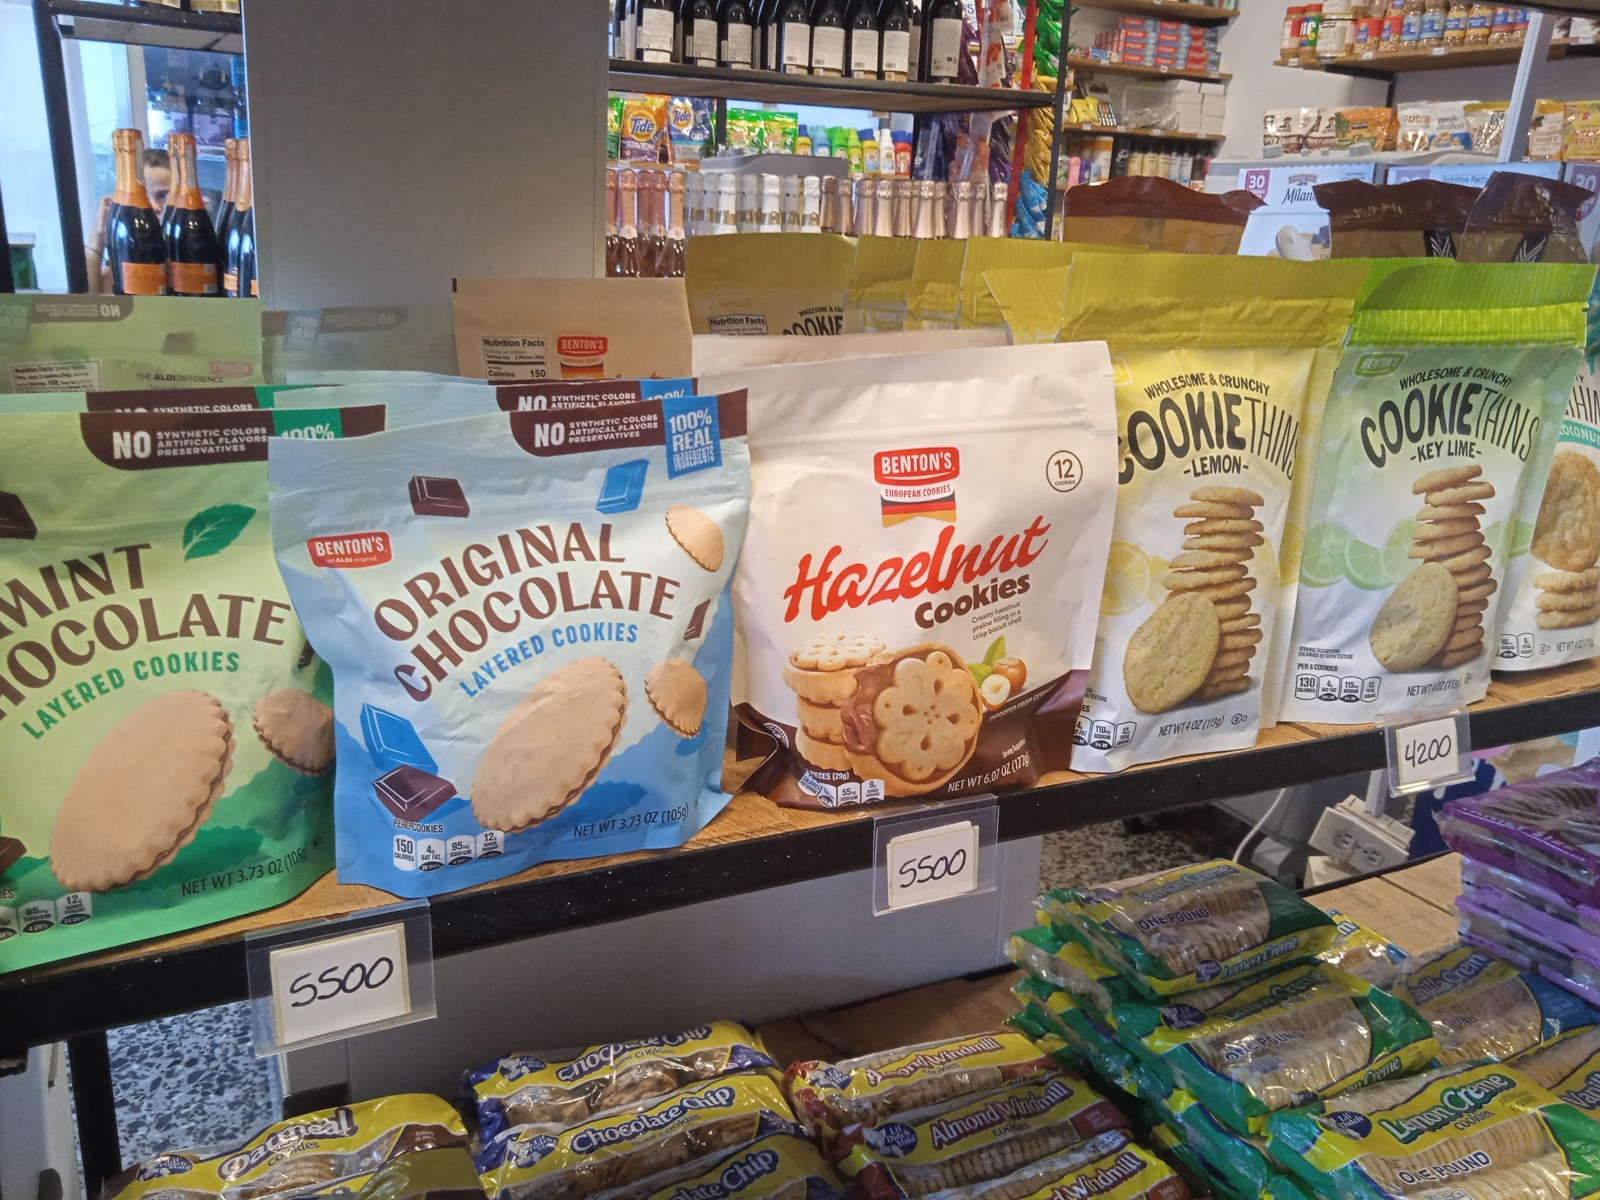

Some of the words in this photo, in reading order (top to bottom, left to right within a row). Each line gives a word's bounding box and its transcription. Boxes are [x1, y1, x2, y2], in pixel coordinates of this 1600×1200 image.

[630, 117, 655, 135] Tide
[673, 110, 691, 124] Tide
[1248, 175, 1265, 189] 30
[711, 317, 745, 327] Nutrition
[745, 316, 766, 325] Facts
[483, 339, 520, 347] Nutrition
[522, 339, 545, 347] Facts
[561, 339, 604, 350] BENTON'S
[488, 370, 515, 378] Calories
[530, 369, 546, 378] 150
[1400, 366, 1463, 391] WHOLESOME
[1463, 366, 1472, 378] &
[1472, 366, 1515, 388] CRUNCHY
[1144, 372, 1206, 400] WHOLESOME
[1209, 372, 1217, 386] &
[1218, 375, 1271, 397] CRUNCHY
[213, 403, 253, 412] COLORS
[518, 395, 548, 411] NO
[551, 394, 600, 403] SYNTHETIC
[601, 392, 636, 400] COLORS
[568, 418, 621, 430] SYNTHETIC
[622, 413, 658, 424] COLORS
[618, 421, 659, 432] FLAVORS
[668, 408, 713, 433] 100%
[156, 428, 220, 440] SYNTHETIC
[222, 426, 268, 437] COLORS
[218, 434, 268, 445] FLAVORS
[534, 423, 566, 448] NO
[568, 430, 641, 444] PRESERVATIVES
[672, 428, 714, 453] REAL
[112, 430, 152, 460] NO
[156, 443, 247, 458] PRESERVATIVES
[672, 446, 716, 473] INGREDIENTS
[881, 451, 953, 475] BENTON'S
[1054, 459, 1075, 480] 12
[884, 486, 922, 499] EUROPEAN
[922, 483, 952, 496] COOKIES
[1054, 478, 1077, 487] cookies
[315, 536, 385, 557] BENTON'S
[783, 514, 1053, 623] Hazelnut
[0, 543, 152, 640] MINT
[373, 521, 627, 642] ORIGINAL
[914, 573, 1032, 630] Cookies
[971, 611, 994, 624] Creamy
[994, 602, 1022, 615] hazelnut
[393, 568, 682, 703] CHOCOLATE
[972, 620, 993, 634] praline
[972, 631, 988, 641] crisp
[1008, 616, 1022, 627] shell
[458, 633, 546, 699] LAYERED
[551, 621, 639, 649] COOKIES
[1313, 664, 1338, 672] COOKIES
[1299, 677, 1316, 687] 130
[1407, 685, 1420, 697] NET
[21, 667, 126, 740] LAYERED
[133, 651, 241, 682] COOKIES
[1158, 723, 1173, 737] NET
[1173, 722, 1187, 735] WT
[1186, 721, 1192, 732] 4
[1192, 719, 1202, 731] OZ
[1202, 715, 1225, 731] (113g)
[1404, 734, 1452, 768] 4200
[832, 771, 850, 781] (29g)
[947, 779, 967, 793] NET
[967, 774, 983, 788] WT
[983, 768, 1001, 784] 6.07
[1001, 764, 1013, 777] OZ
[412, 822, 444, 833] COOKIES
[573, 824, 597, 838] NET
[598, 818, 619, 834] WT
[619, 814, 643, 831] 3.73
[644, 811, 660, 826] OZ
[661, 803, 690, 825] (105g)
[394, 852, 415, 862] CALORIES
[395, 838, 414, 855] 150
[450, 849, 472, 858] SODIUM
[182, 878, 208, 897] NET
[211, 871, 234, 889] WT
[237, 864, 265, 883] 3.73
[268, 858, 285, 876] OZ
[899, 848, 967, 889] 5500
[1182, 863, 1232, 885] Creme
[1138, 914, 1168, 931] ONE
[1167, 908, 1211, 926] POUND
[1222, 954, 1260, 980] Lemon
[1261, 938, 1299, 962] Creme
[1442, 952, 1490, 984] Crem
[289, 956, 394, 1008] 5500
[1258, 1030, 1306, 1050] POUND
[925, 1037, 1001, 1067] Windmill
[1362, 1056, 1401, 1087] Creme
[931, 1103, 1001, 1150] Almond
[999, 1081, 1069, 1120] Windmill
[1380, 1103, 1448, 1141] Lemon
[1442, 1073, 1509, 1113] Creme
[571, 1106, 682, 1154] Chocolate
[681, 1088, 732, 1110] Chip
[1338, 1114, 1365, 1129] Dutch
[1453, 1110, 1496, 1132] cookies
[886, 1129, 911, 1144] Dutch
[896, 1135, 917, 1147] Maid
[722, 1152, 774, 1191] Chip
[1065, 1153, 1142, 1199] Windmill
[1398, 1169, 1438, 1186] ONE
[1437, 1150, 1492, 1178] POUND
